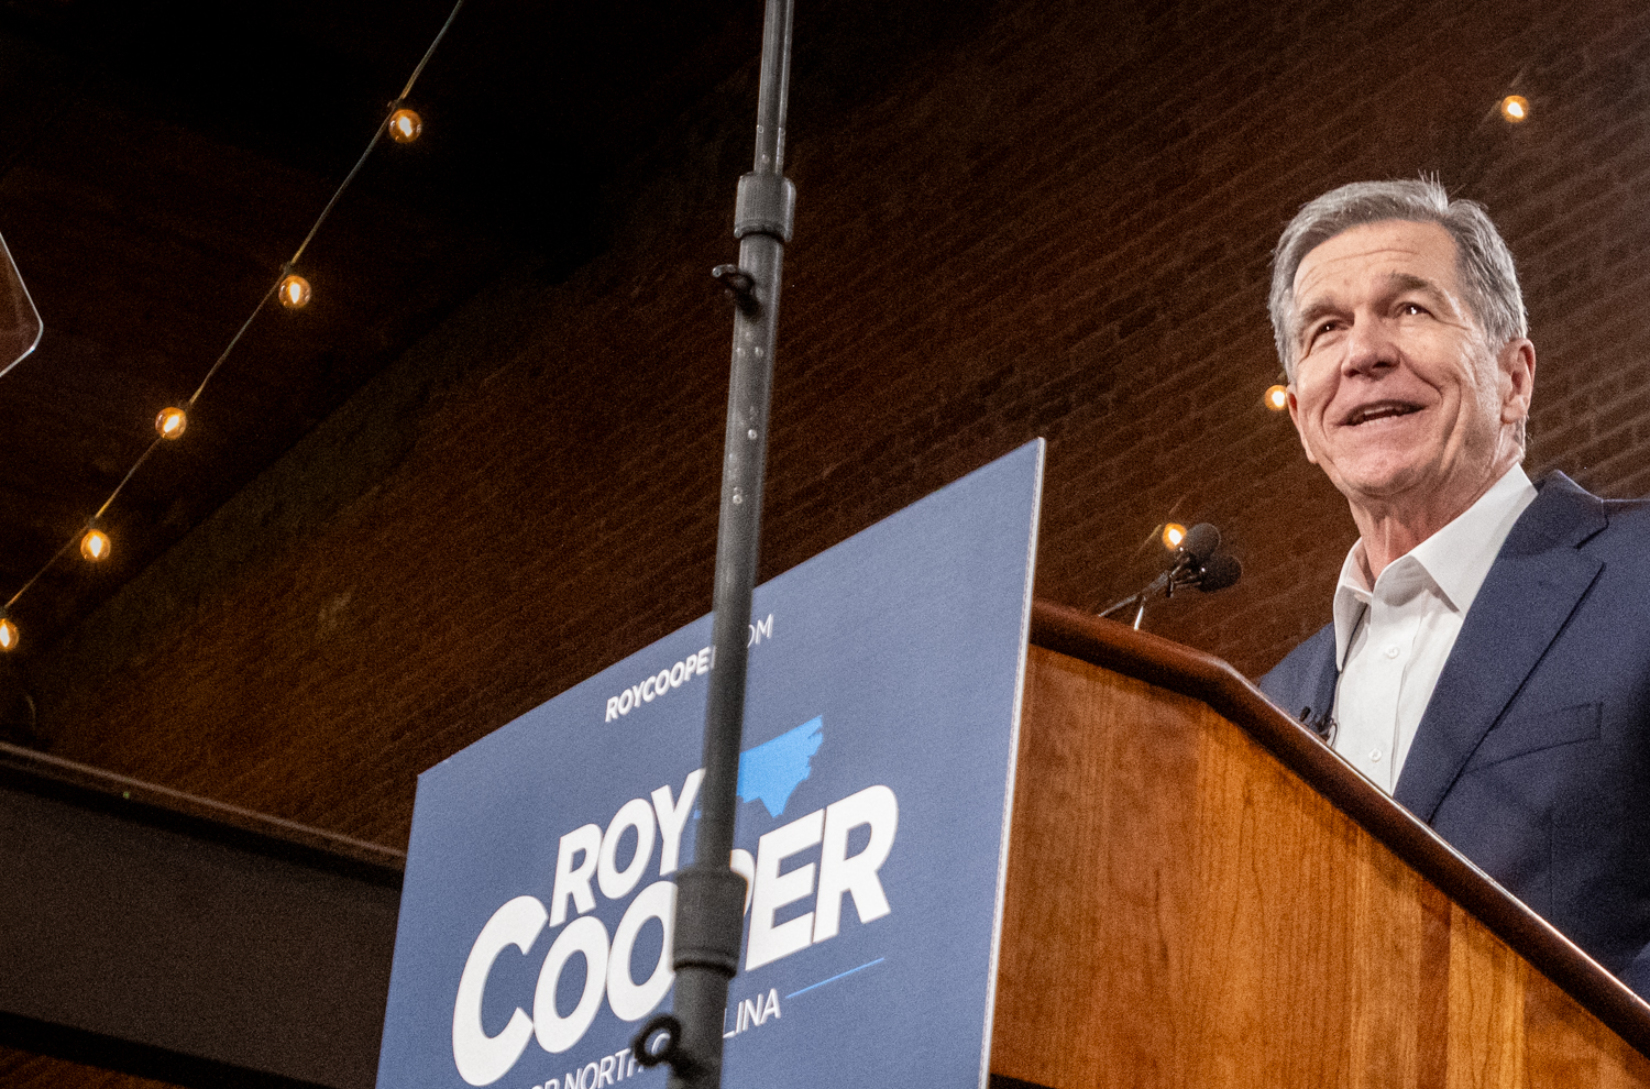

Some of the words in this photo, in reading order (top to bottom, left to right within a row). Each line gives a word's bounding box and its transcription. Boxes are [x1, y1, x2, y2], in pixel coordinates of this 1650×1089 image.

[605, 613, 774, 722] ROYCOOPEM
[549, 768, 706, 927] ROY
[652, 988, 781, 1054] LINA
